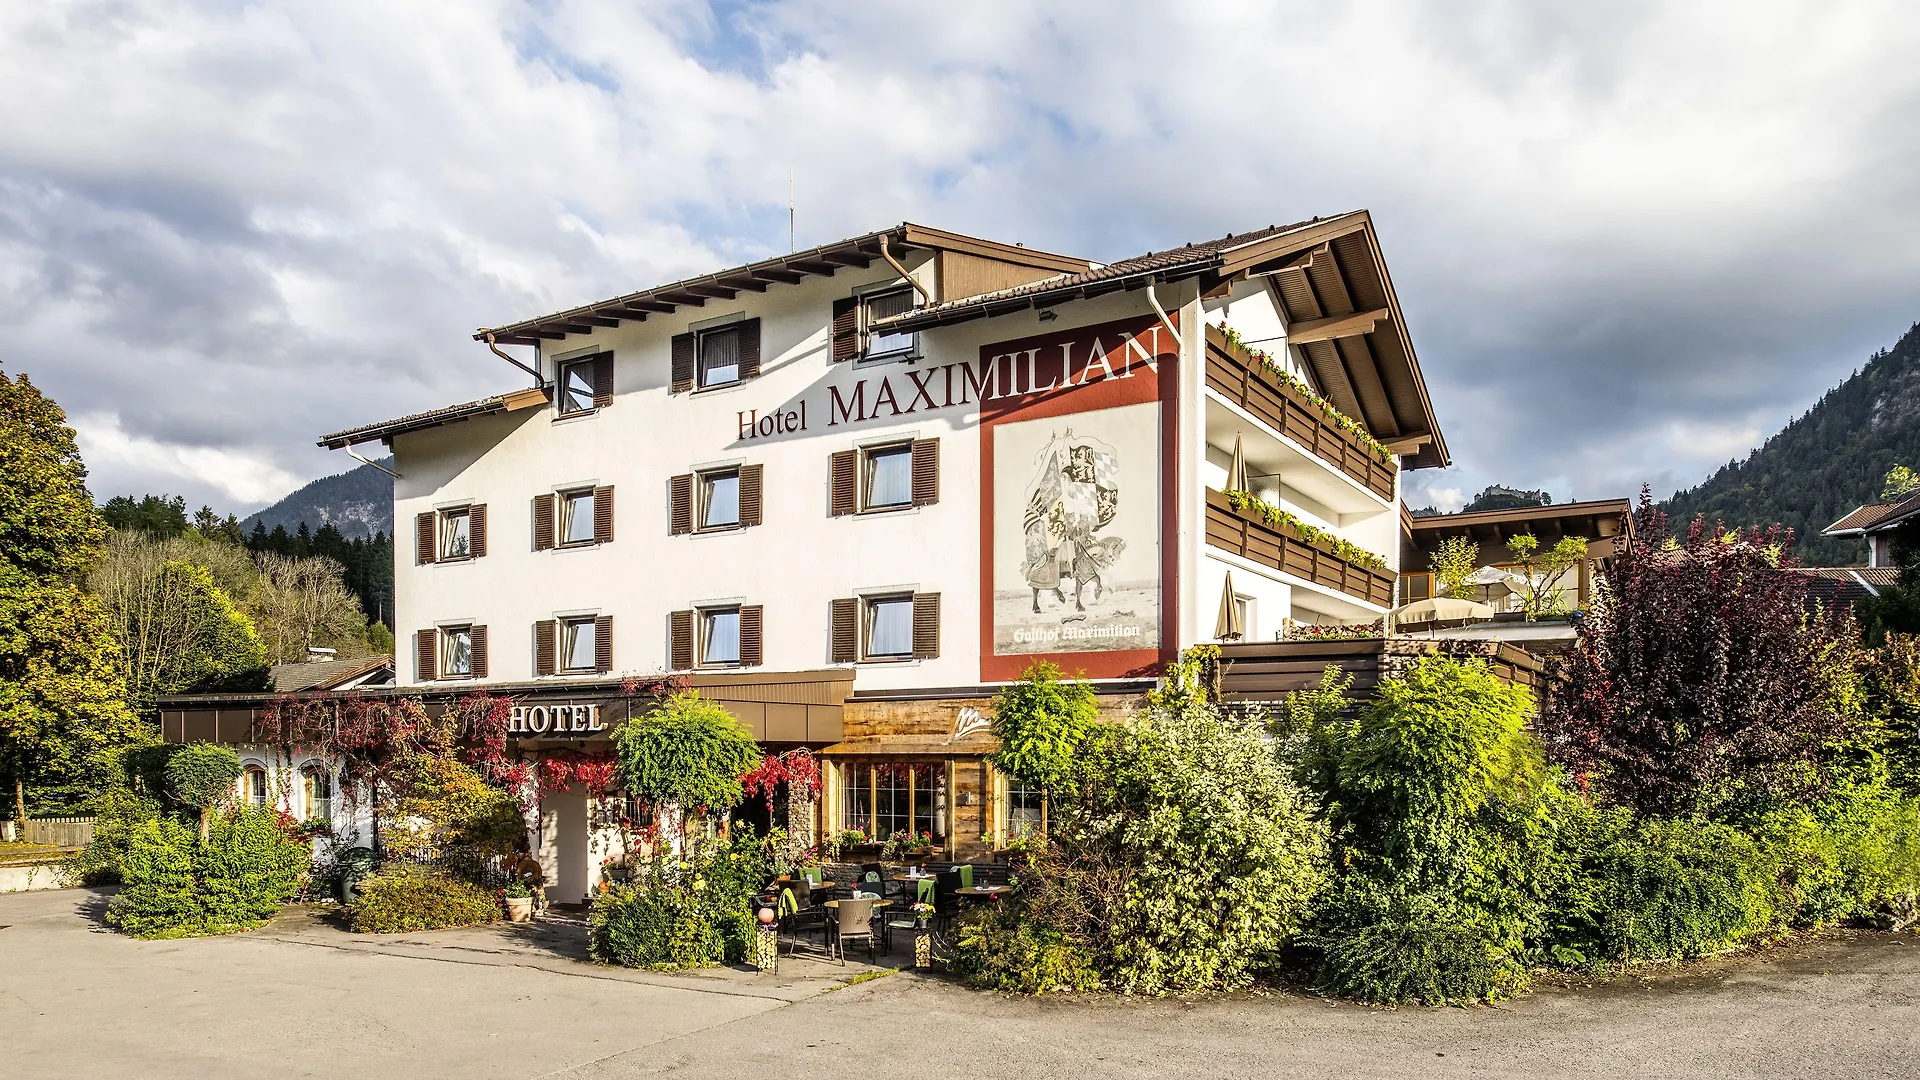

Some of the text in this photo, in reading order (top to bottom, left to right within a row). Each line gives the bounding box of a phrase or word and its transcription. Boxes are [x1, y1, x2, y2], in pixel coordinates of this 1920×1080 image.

[736, 326, 1163, 440] Hotel MAXIMILIAN
[1062, 625, 1141, 640] Maximilian
[508, 704, 605, 732] HOTEL
